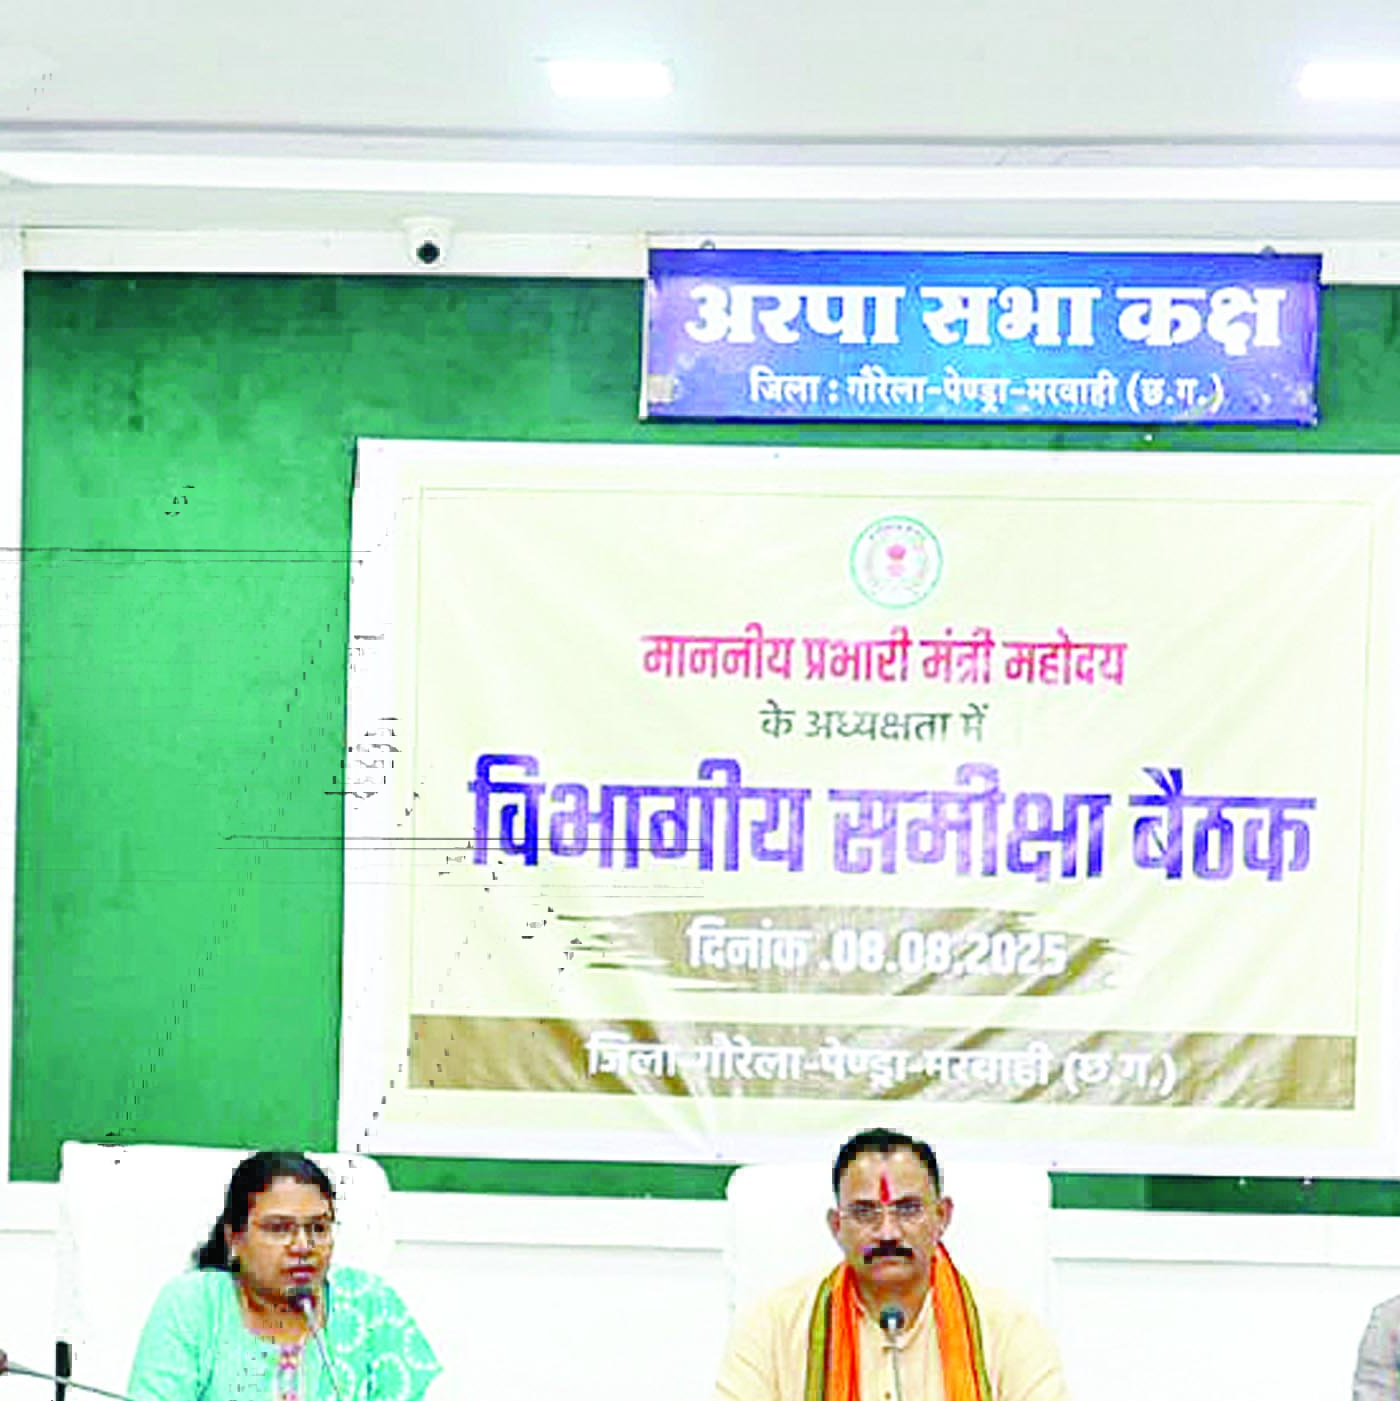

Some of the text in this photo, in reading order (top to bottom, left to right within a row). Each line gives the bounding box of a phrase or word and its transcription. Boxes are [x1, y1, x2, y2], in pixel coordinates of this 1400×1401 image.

[684, 284, 1288, 357] अरपा सभा कक्ष
[750, 365, 821, 403] जिला
[641, 622, 1127, 686] माननीय प्रभारी मंत्री महोदय
[759, 700, 990, 742] के अध्यक्षता में
[468, 754, 1317, 883] विभागीय समीक्षा बैठक
[687, 916, 812, 971] दिनांक
